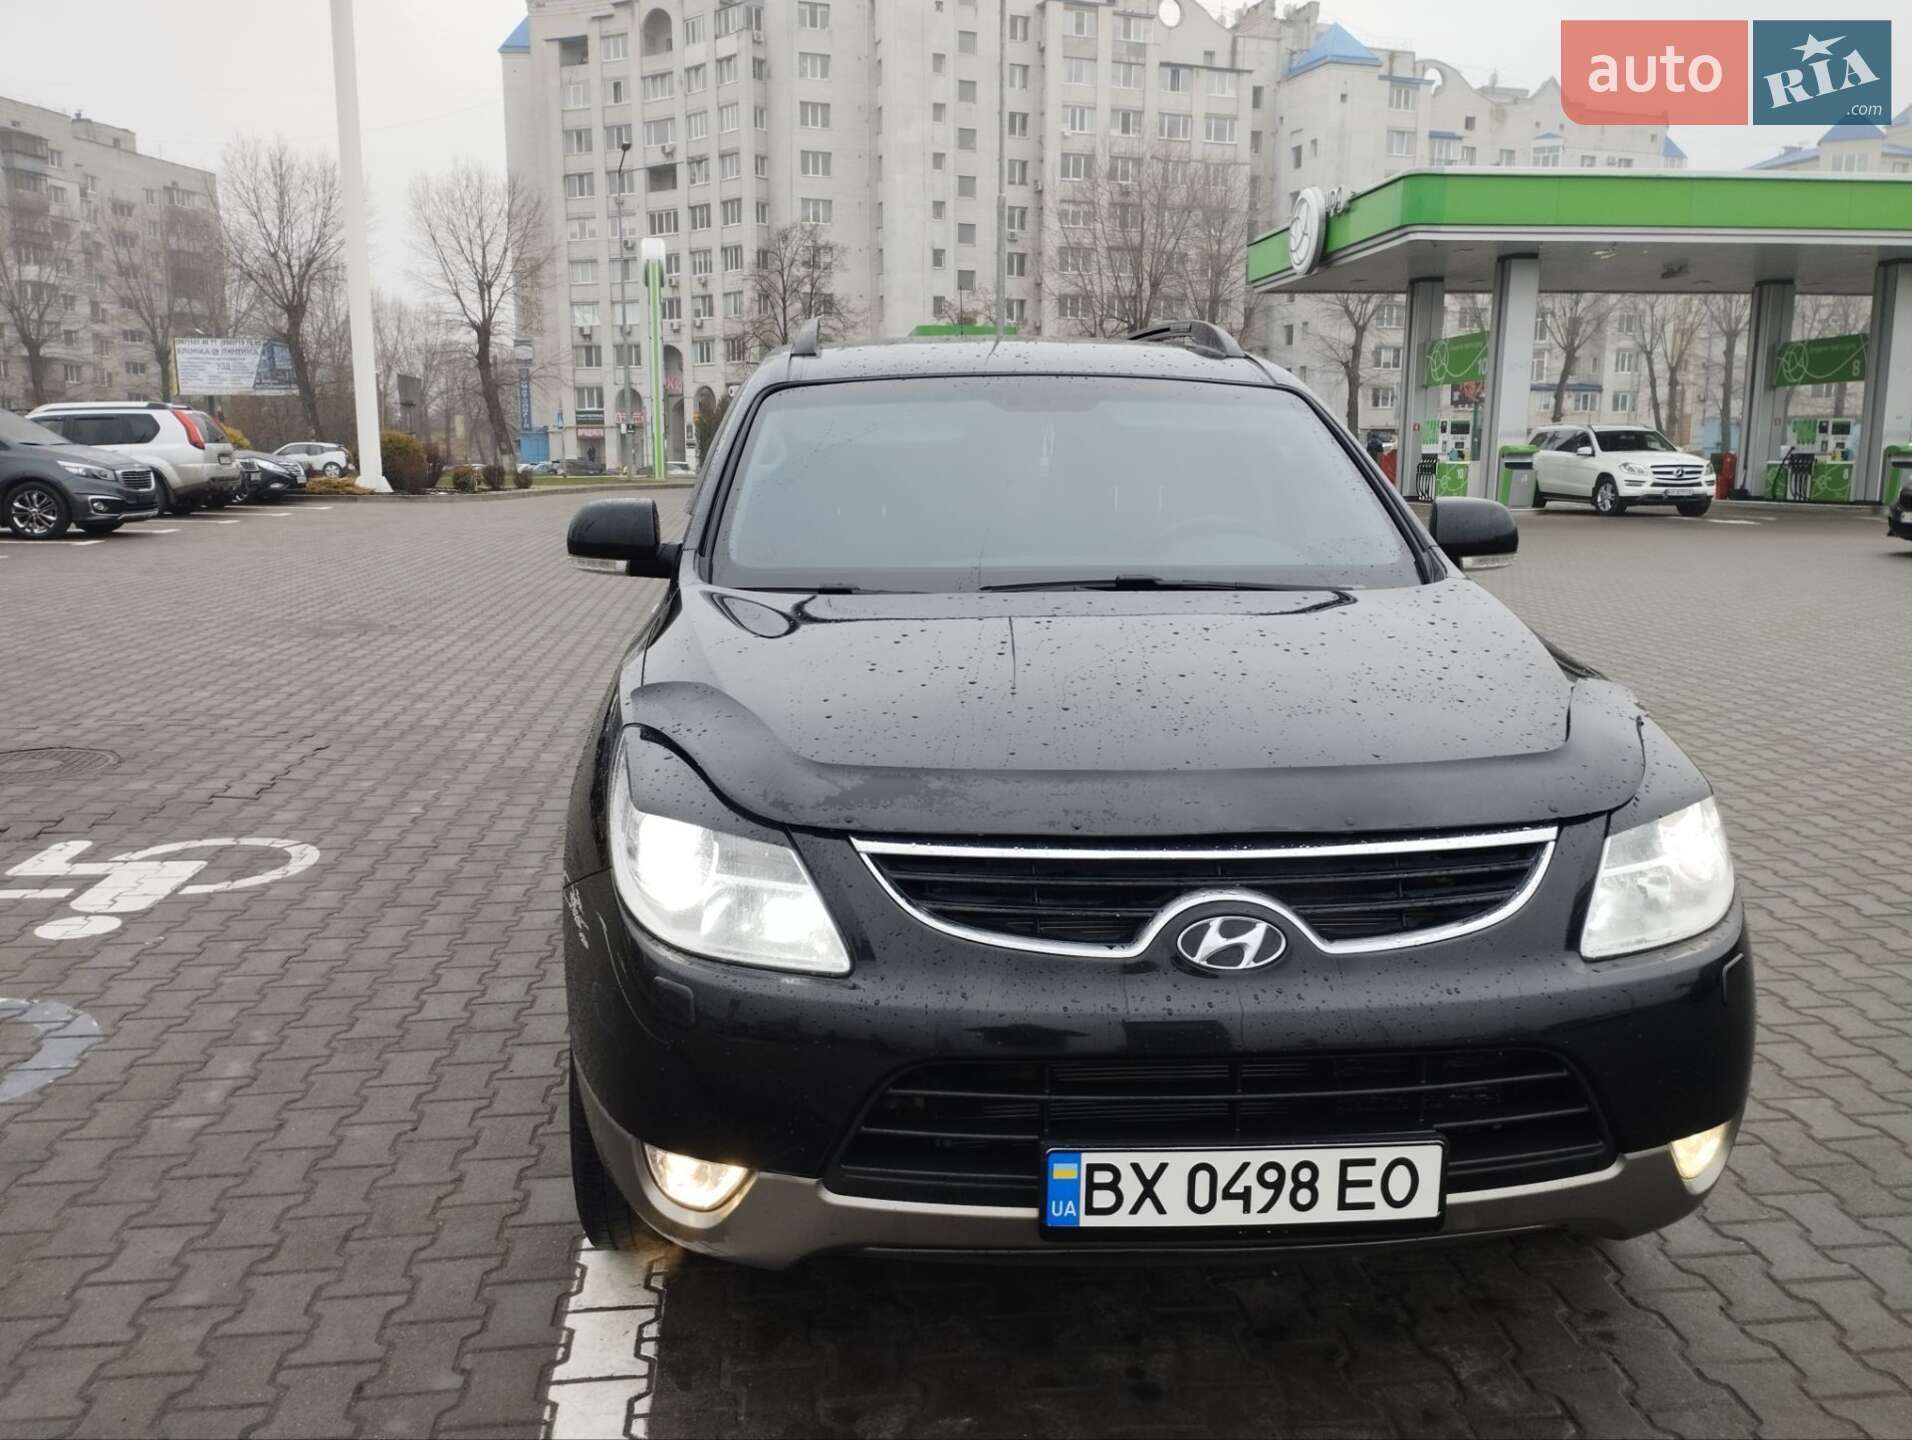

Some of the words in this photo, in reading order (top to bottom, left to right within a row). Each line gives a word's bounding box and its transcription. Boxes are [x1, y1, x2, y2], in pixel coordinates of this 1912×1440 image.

[1477, 358, 1488, 376] 10
[1852, 359, 1861, 376] 8
[1084, 1161, 1169, 1216] BX
[1186, 1160, 1320, 1214] 0498
[1337, 1156, 1420, 1211] EO
[1051, 1200, 1077, 1217] UA
